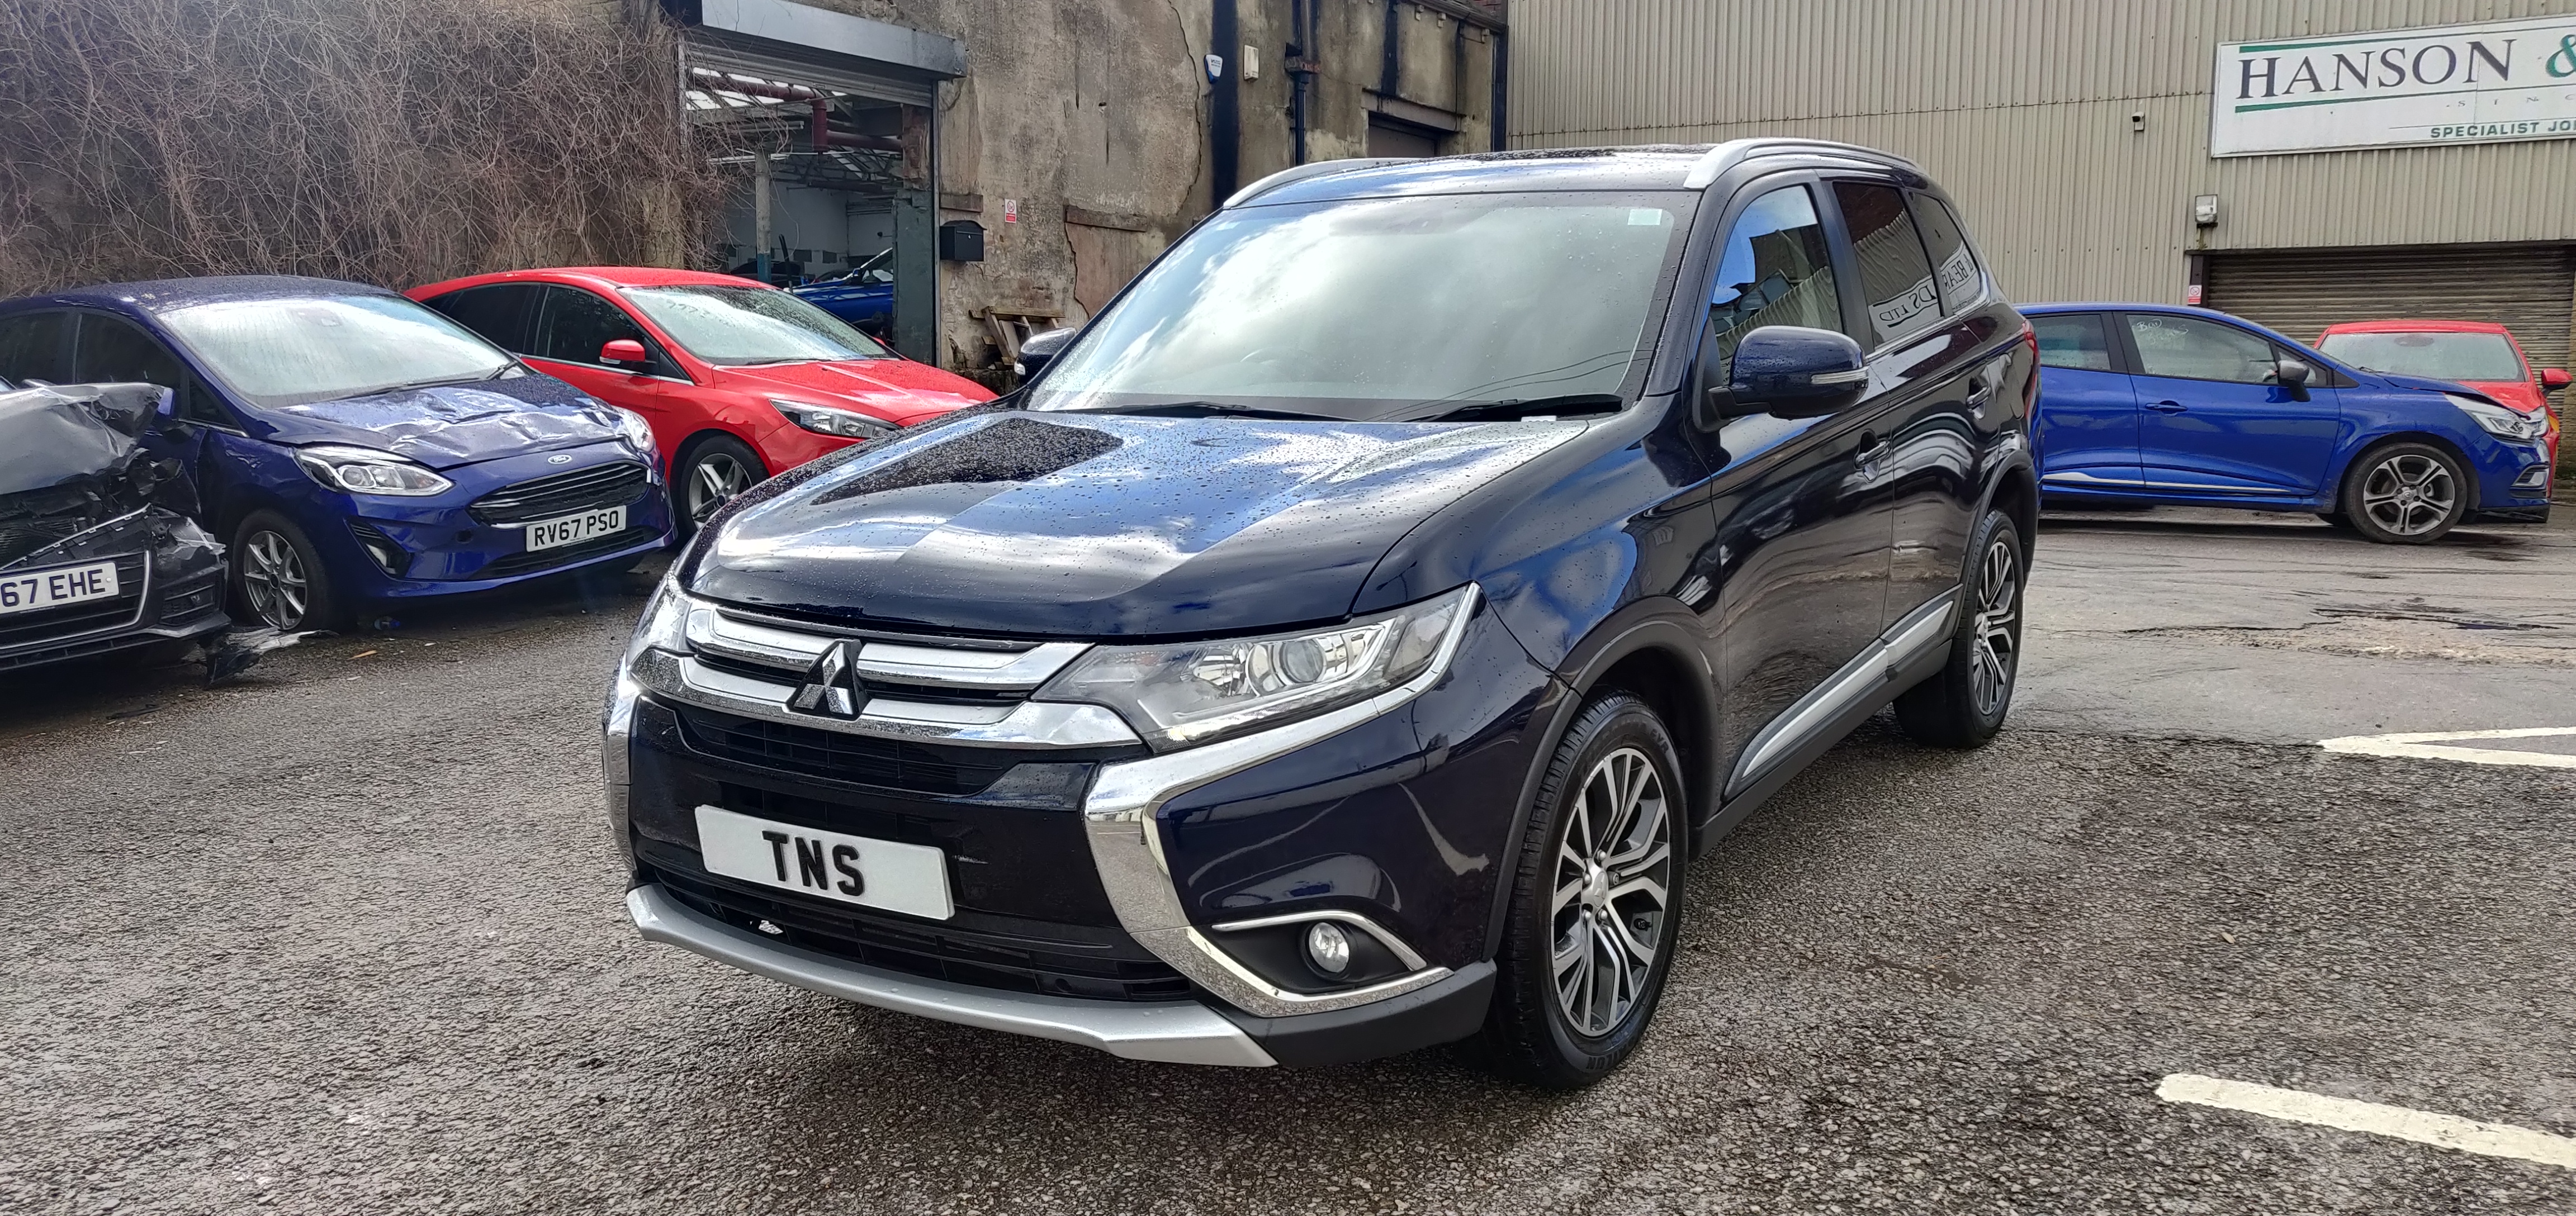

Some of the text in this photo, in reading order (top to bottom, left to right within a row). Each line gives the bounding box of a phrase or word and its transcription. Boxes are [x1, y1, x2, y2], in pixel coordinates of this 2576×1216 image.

[2236, 39, 2517, 99] HANSON
[2430, 122, 2540, 138] SPECIALIST
[534, 518, 581, 547] RV67
[586, 510, 618, 535] PSO
[1, 568, 106, 607] 67 EHE
[761, 830, 865, 897] TNS
